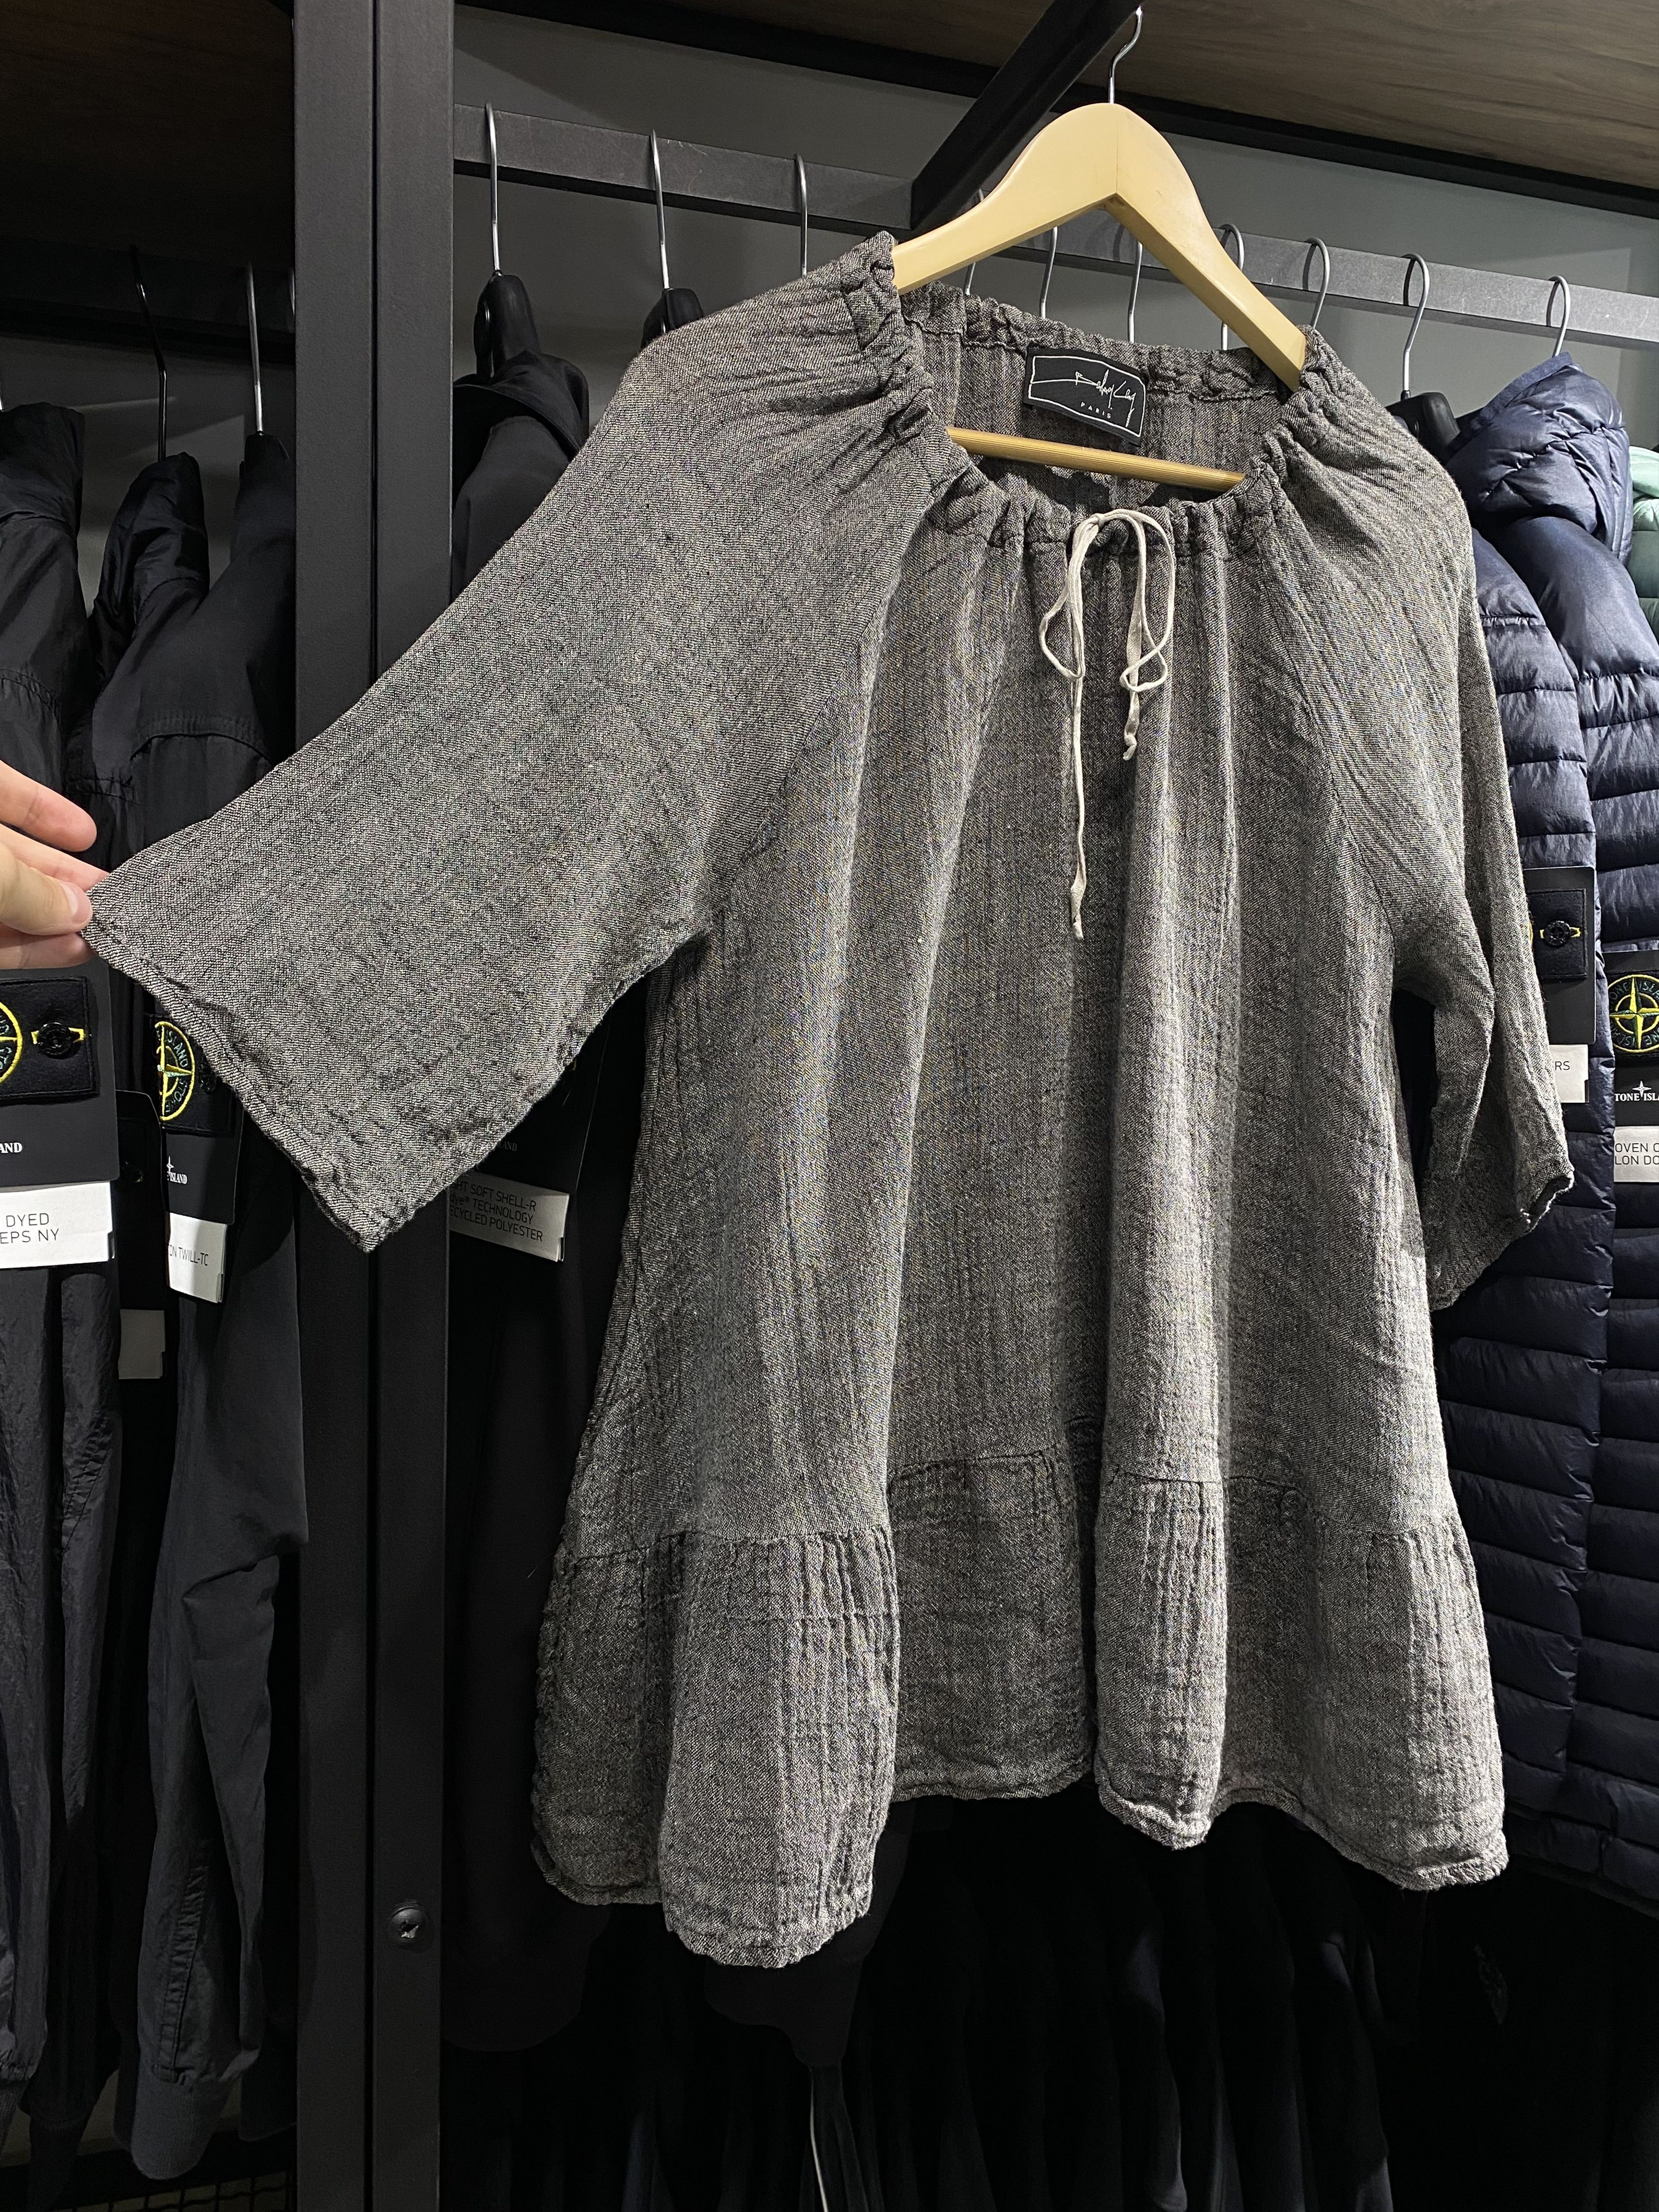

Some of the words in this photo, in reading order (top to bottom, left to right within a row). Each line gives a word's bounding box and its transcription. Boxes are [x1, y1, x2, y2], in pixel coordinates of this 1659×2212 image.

[1081, 402, 1111, 419] PARIS
[1555, 1061, 1570, 1070] RS
[1614, 1093, 1640, 1101] TONE
[1643, 1092, 1659, 1101] ISL
[1615, 1143, 1648, 1153] OVEN
[1614, 1156, 1639, 1165] LON
[471, 1184, 494, 1199] SOFT
[496, 1191, 537, 1211] SHELL-R
[473, 1198, 533, 1225] TECHNOLOGY
[6, 1213, 49, 1228] DYED
[0, 1230, 31, 1244] EPS
[38, 1229, 59, 1242] NY
[490, 1217, 543, 1242] POLYESTER
[178, 1247, 209, 1266] TWILL-TC
